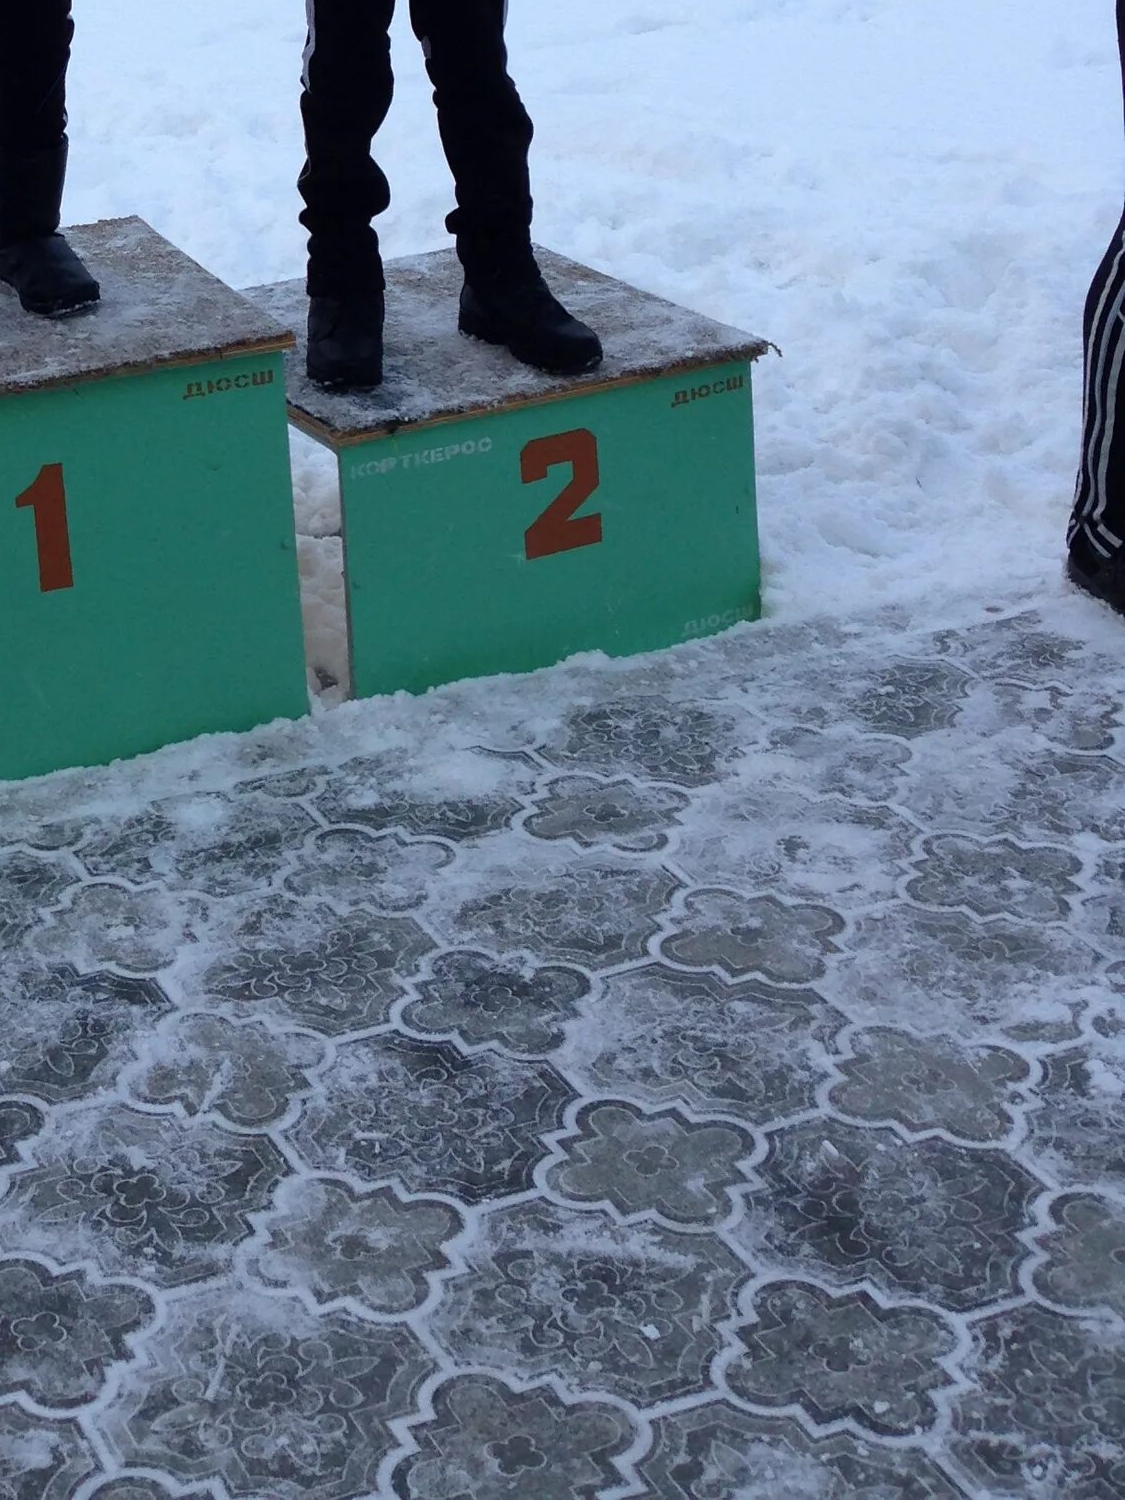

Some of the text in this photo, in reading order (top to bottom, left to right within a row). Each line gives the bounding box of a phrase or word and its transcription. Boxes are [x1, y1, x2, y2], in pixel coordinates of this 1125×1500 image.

[182, 369, 275, 401] ДЮСШ
[670, 375, 744, 408] ДЮСШ
[15, 462, 74, 593] 1
[520, 428, 603, 560] 2
